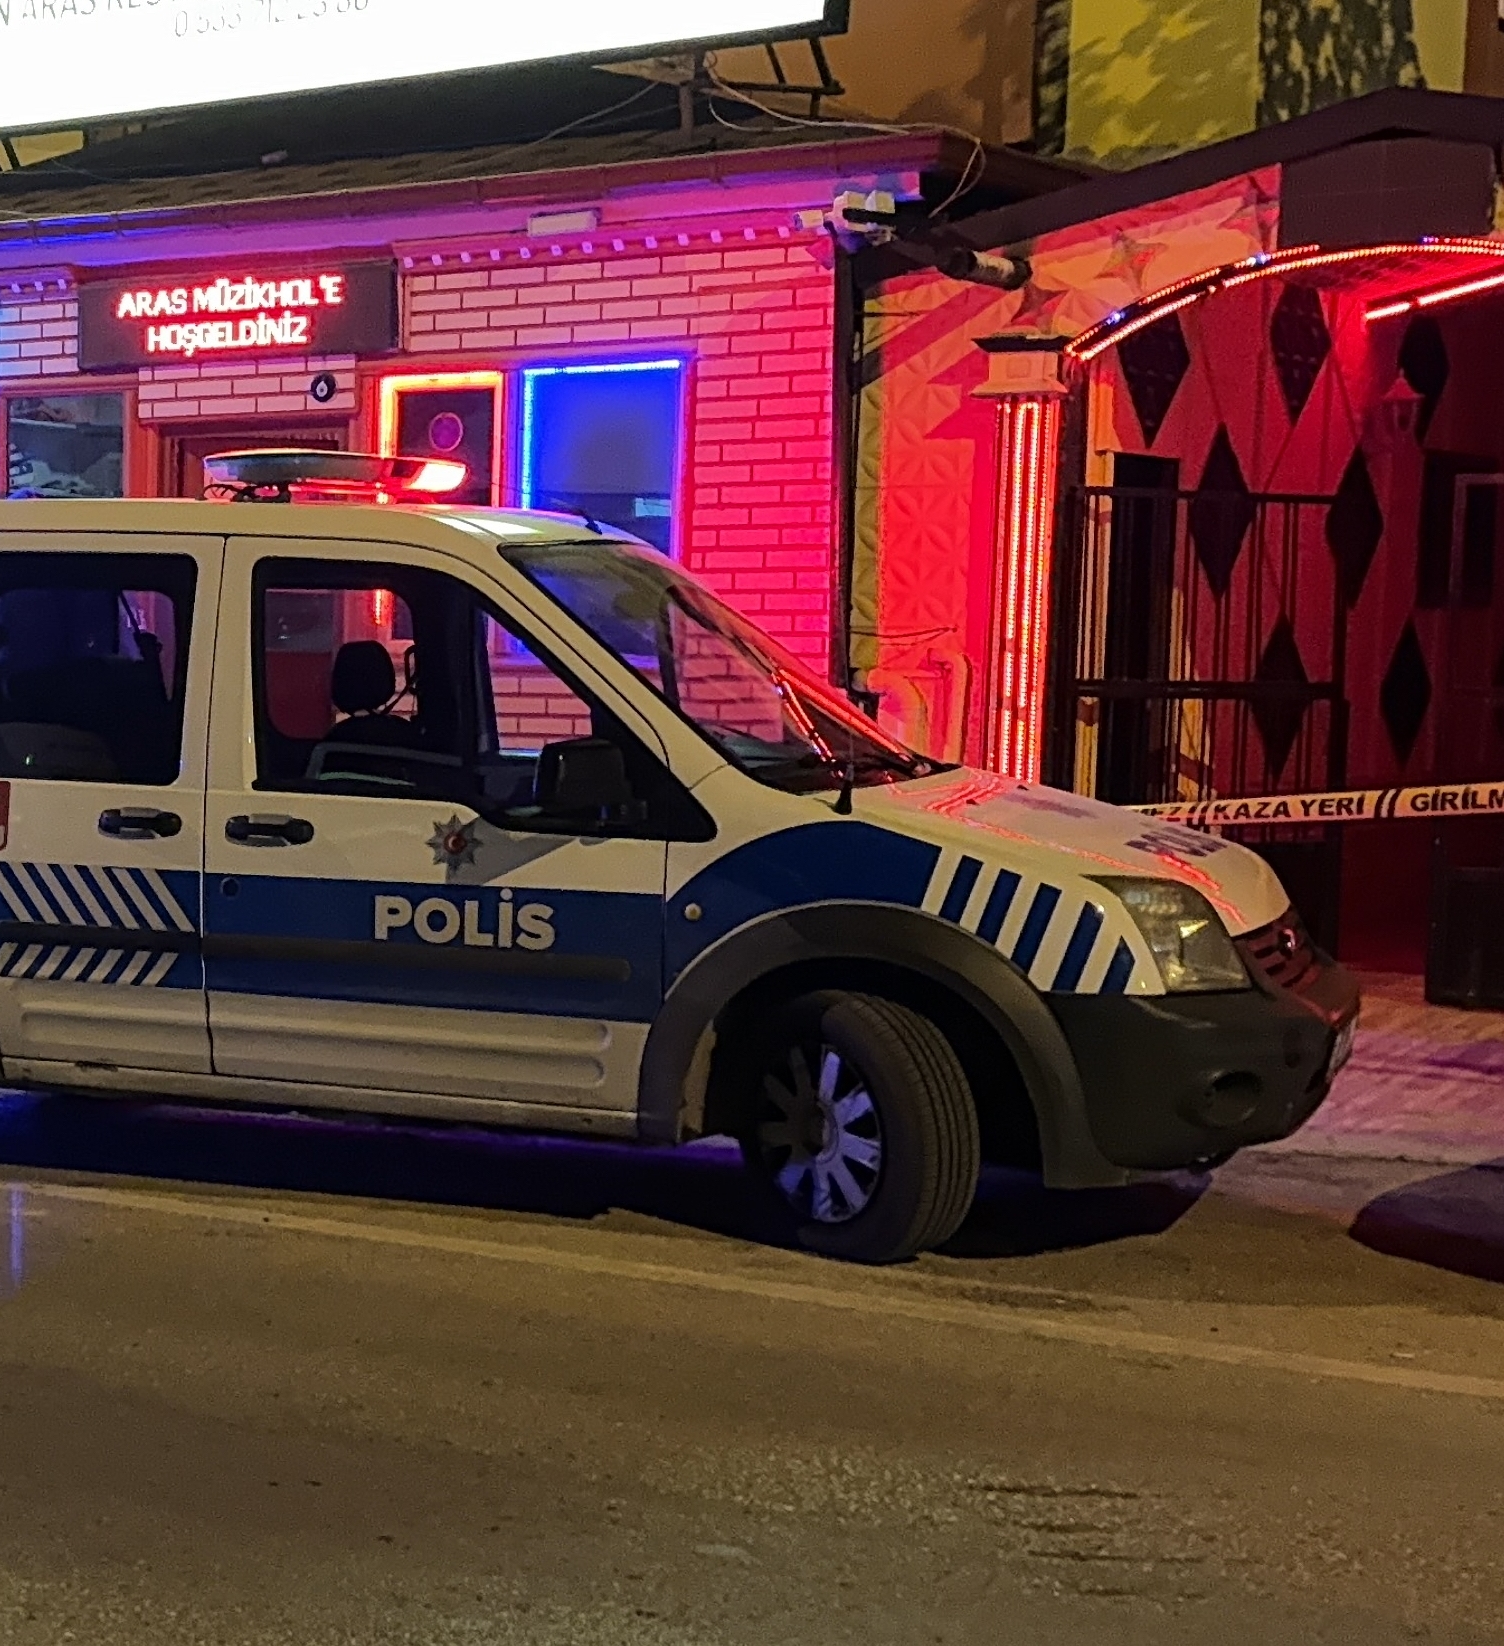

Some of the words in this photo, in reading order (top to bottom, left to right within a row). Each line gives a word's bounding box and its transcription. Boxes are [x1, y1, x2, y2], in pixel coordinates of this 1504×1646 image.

[117, 289, 188, 318] ARAS
[193, 275, 343, 313] MÜZİKHOL'E
[148, 310, 308, 357] HOŞGELDİNİZ
[1212, 801, 1292, 821] KAZA
[374, 888, 556, 951] POLİS
